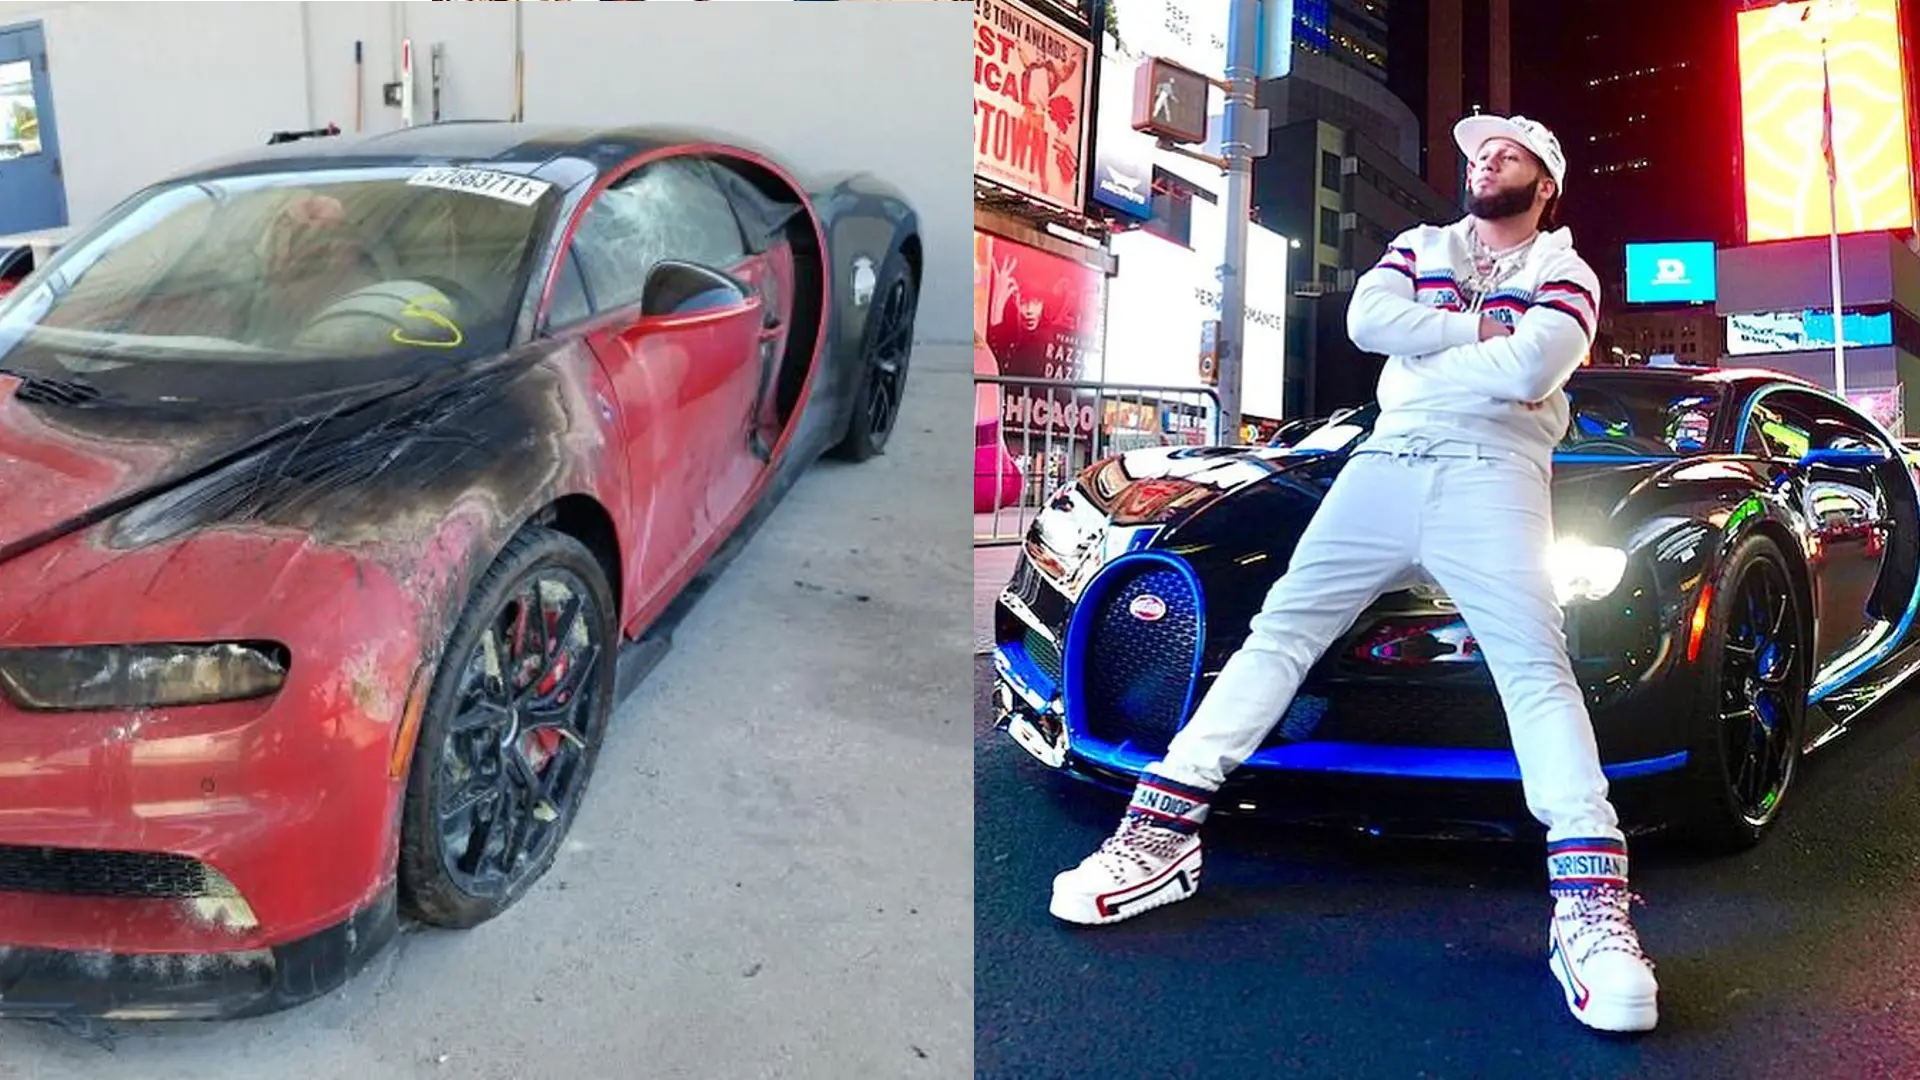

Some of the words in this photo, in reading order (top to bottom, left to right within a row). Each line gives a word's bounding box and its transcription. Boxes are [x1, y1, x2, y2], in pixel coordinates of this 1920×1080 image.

[974, 20, 1015, 64] ST
[993, 5, 1022, 38] TONY
[1024, 23, 1068, 63] AWARDS
[974, 98, 1048, 194] TOWN
[1002, 393, 1095, 432] HICAGO
